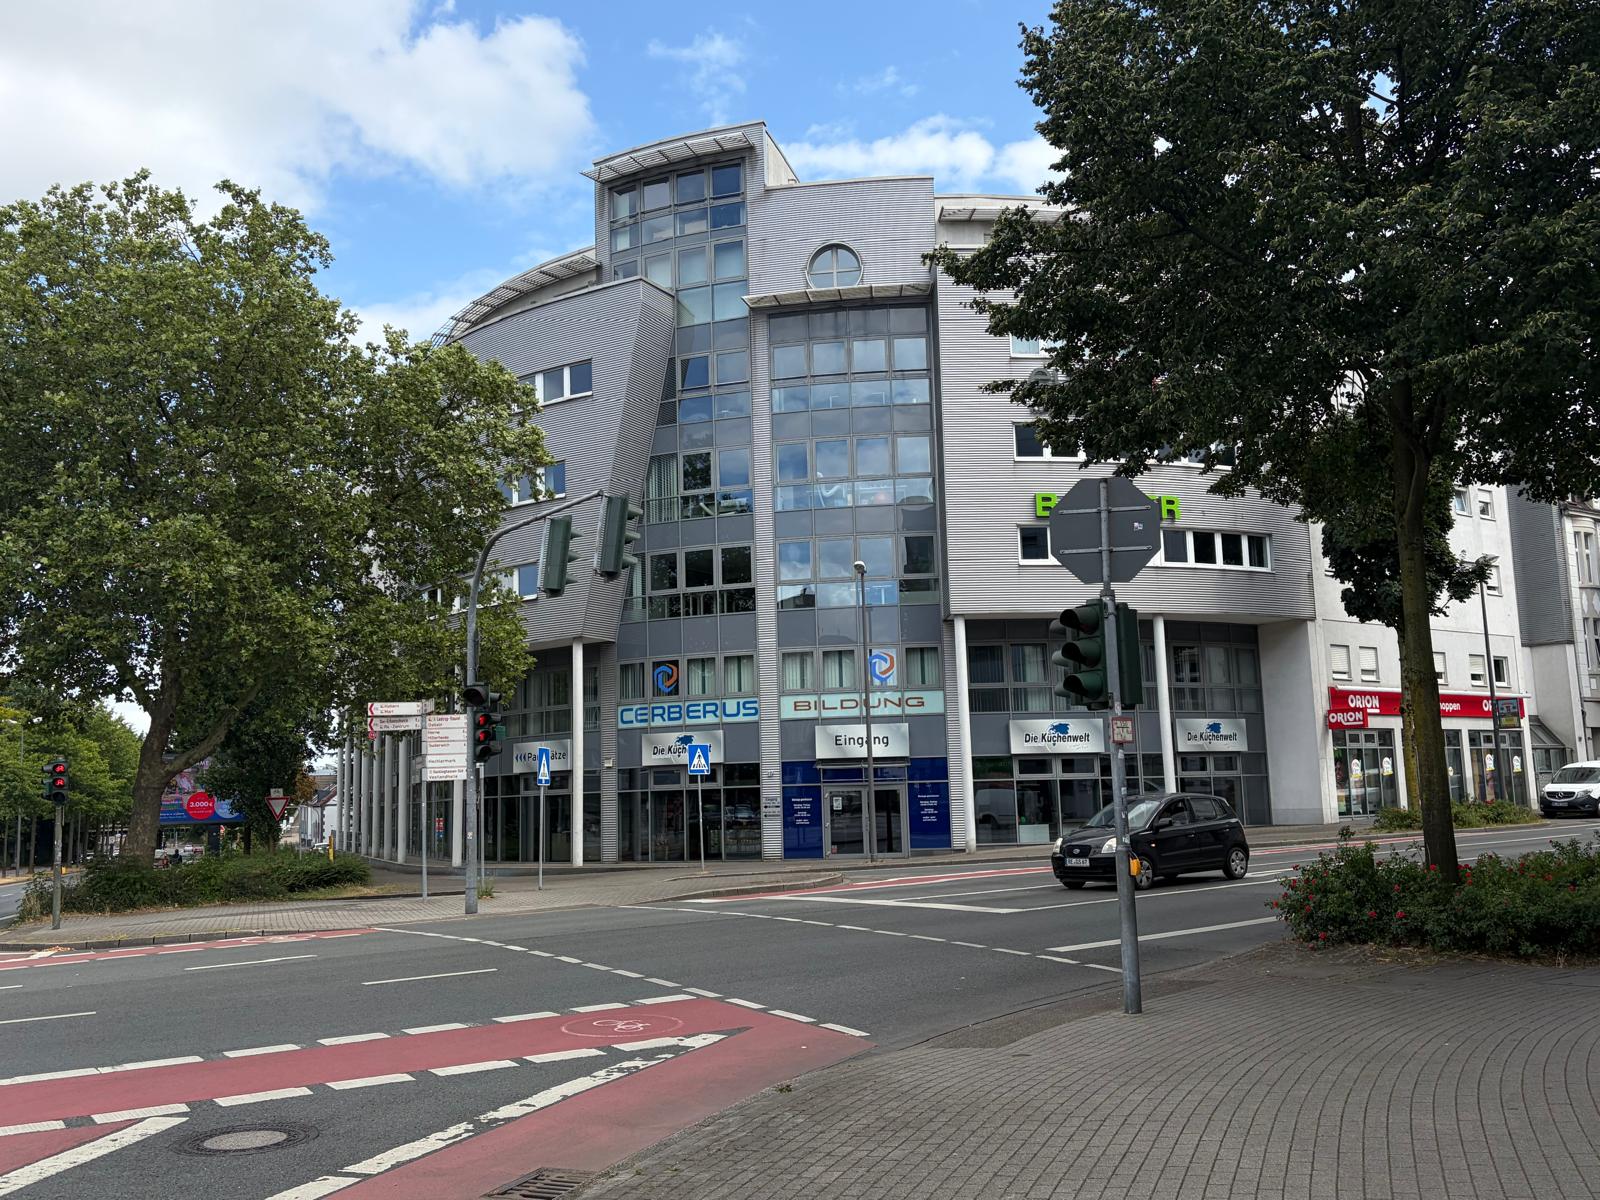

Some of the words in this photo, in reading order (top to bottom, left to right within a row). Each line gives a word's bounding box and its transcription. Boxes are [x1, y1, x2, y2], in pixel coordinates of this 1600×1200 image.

[1348, 694, 1380, 709] ORION
[620, 699, 759, 725] CERBERUS
[793, 696, 926, 712] BILDUNG
[1329, 711, 1364, 724] ORION
[1024, 733, 1040, 743] Die
[1041, 732, 1090, 743] Küchenwelt
[1187, 732, 1198, 741] Die
[1199, 732, 1237, 741] Küchenwelt
[653, 745, 665, 756] Die
